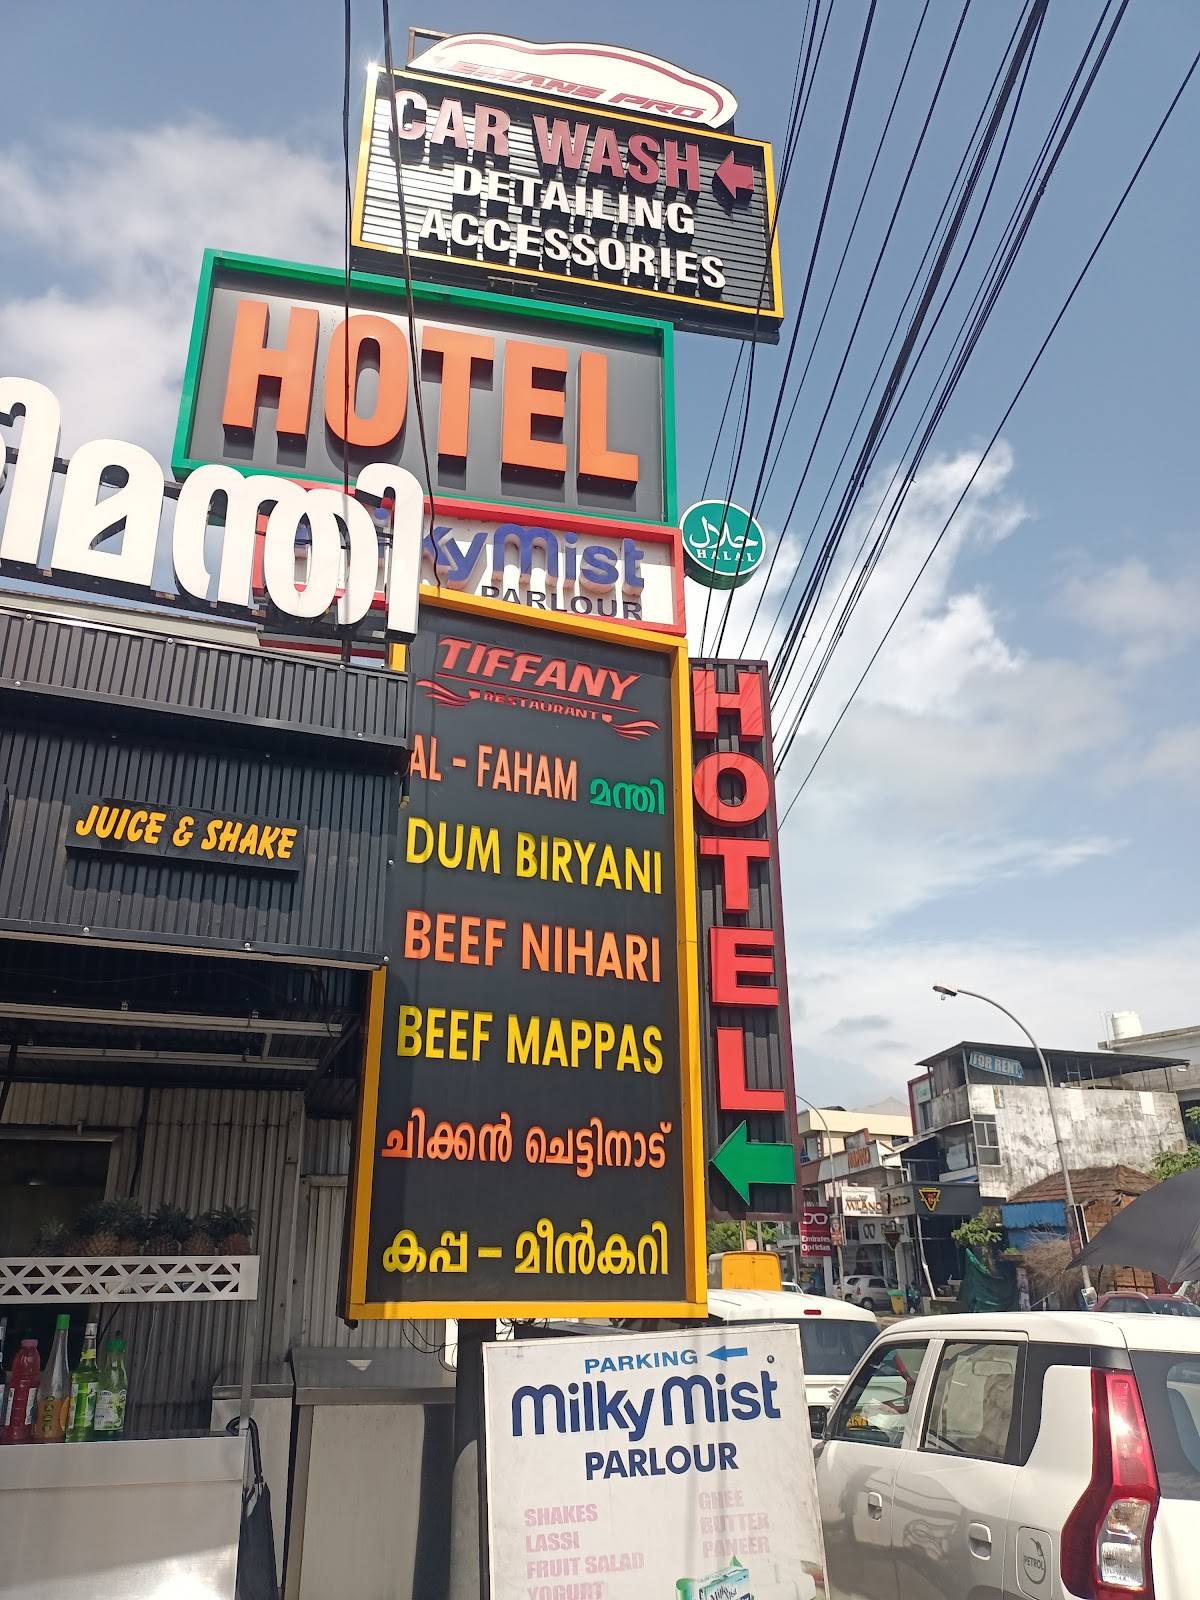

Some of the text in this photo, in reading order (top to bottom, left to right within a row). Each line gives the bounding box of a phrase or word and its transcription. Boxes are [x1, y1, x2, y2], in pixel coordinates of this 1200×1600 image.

[608, 93, 706, 119] PRO
[389, 89, 700, 192] CAR WASH
[452, 164, 696, 235] DETAILING
[419, 208, 727, 289] ACCESSORIES
[222, 299, 640, 484] HOTEL
[0, 376, 424, 636] ിമന്തി
[689, 516, 759, 549] حلال
[697, 548, 756, 562] HALAL
[481, 585, 643, 621] PARLOUR
[438, 636, 641, 701] TIFFANY
[483, 690, 598, 721] RESTAURANT
[410, 734, 443, 782] AL
[477, 743, 578, 802] FAHAM
[589, 777, 666, 815] മന്തി
[75, 804, 298, 860] JUICE & SHAKE
[406, 816, 663, 895] DUM BIRYANI
[692, 669, 785, 1112] HOTEL
[404, 909, 661, 983] BEEF NIHARI
[396, 1005, 664, 1075] BEEF MAPPAS
[973, 1052, 1021, 1076] FOR RENT
[382, 1106, 514, 1163] ചിക്കൻ
[382, 1229, 469, 1274] കപ്പ
[584, 1350, 698, 1374] PARKING
[585, 1443, 739, 1481] PARLOUR
[524, 1503, 598, 1527] SHAKES
[525, 1530, 581, 1553] LASSI
[1023, 1554, 1045, 1571] PETROL
[526, 1552, 645, 1579] FRUIT SALAD
[527, 1580, 606, 1600] YOGURT
